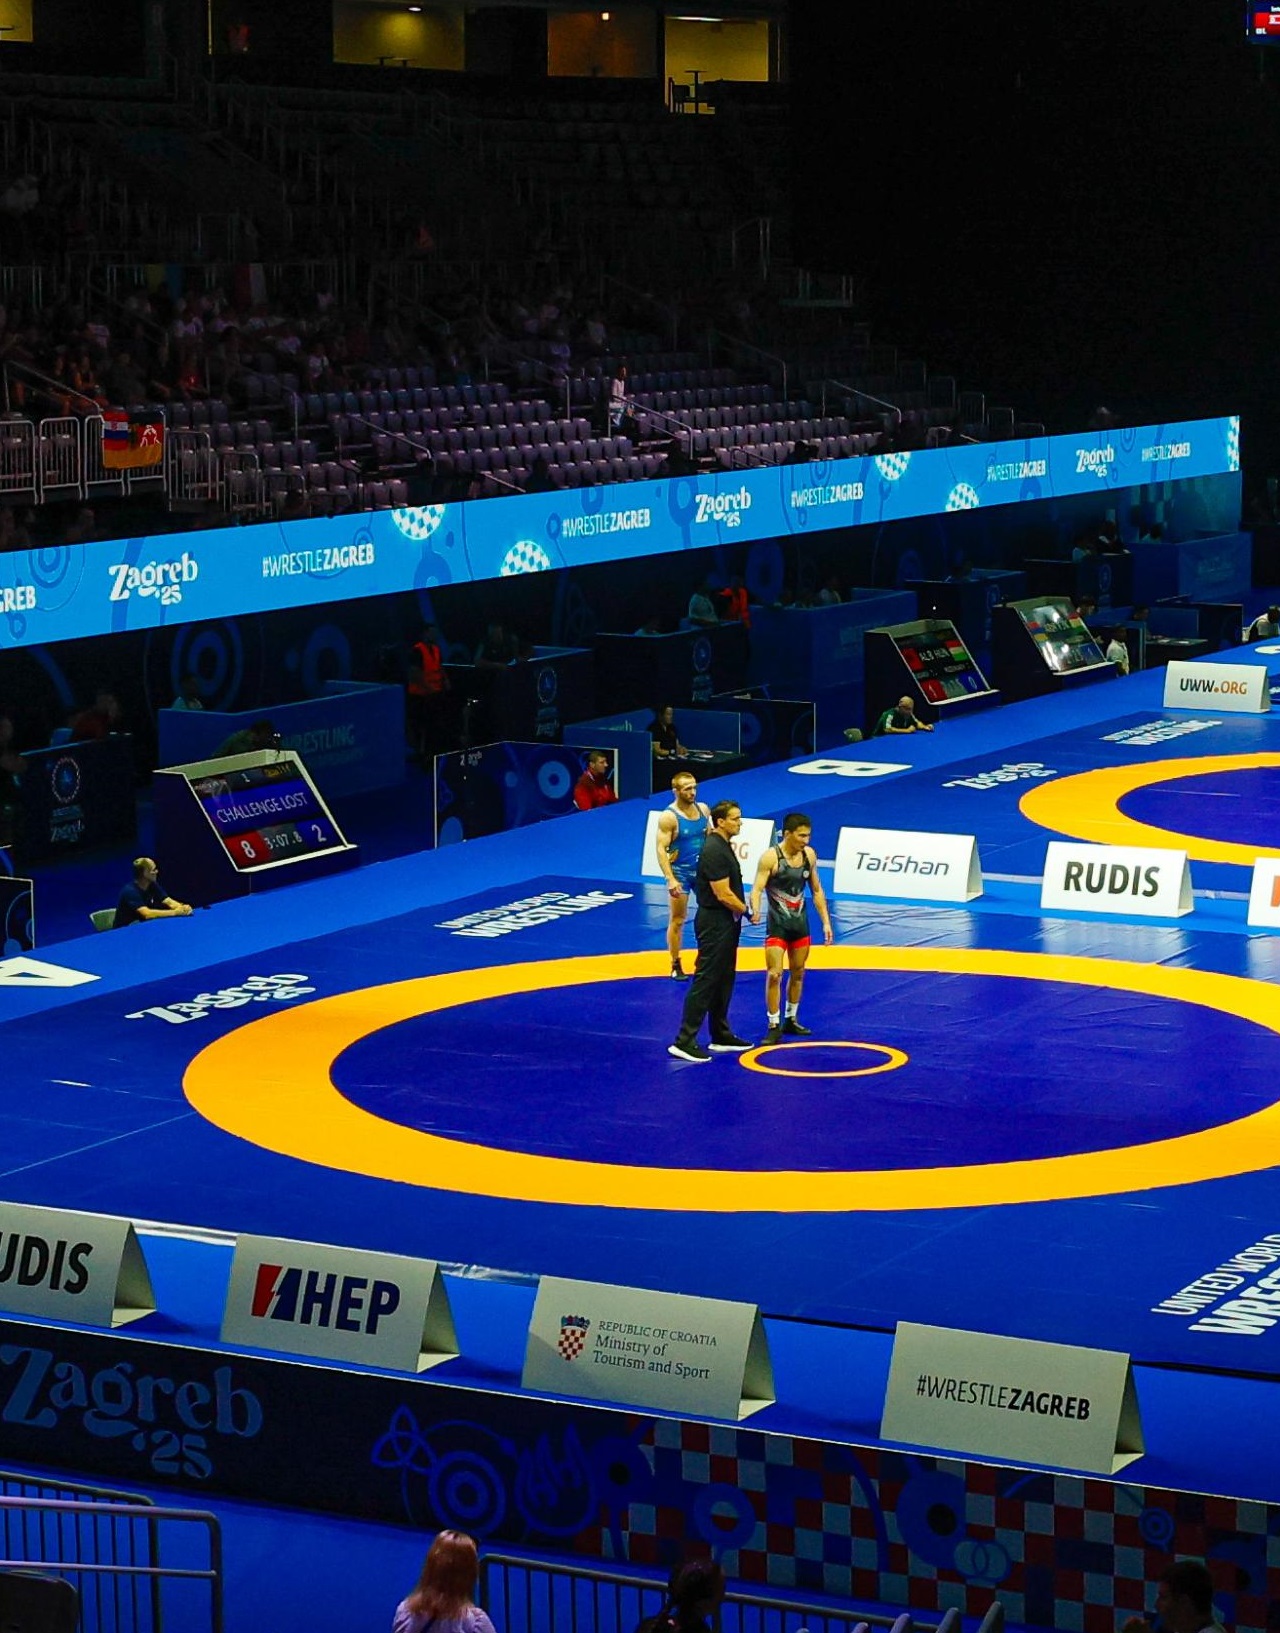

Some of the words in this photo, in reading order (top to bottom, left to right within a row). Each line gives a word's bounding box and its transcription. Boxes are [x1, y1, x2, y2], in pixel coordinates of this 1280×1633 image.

[1076, 444, 1115, 472] Zagreb
[694, 486, 751, 524] Zagreb
[562, 508, 651, 539] #WRESTLEZAGREB
[262, 542, 375, 578] #WRESTLEZAGREB
[108, 552, 198, 601] Zagreb
[1180, 678, 1248, 696] UWW.ORG
[787, 758, 912, 778] B
[216, 798, 282, 823] CHALLENGE
[280, 792, 308, 810] LOST
[311, 824, 327, 842] 2
[240, 840, 256, 859] 8
[855, 852, 950, 877] TaiShan
[1063, 860, 1160, 898] RUDIS
[451, 890, 634, 938] WRESTLING
[125, 973, 308, 1024] Zagreb
[300, 1268, 400, 1335] HEP
[1151, 1271, 1231, 1316] UNITED
[596, 1334, 646, 1358] Ministry
[650, 1342, 666, 1356] of
[599, 1320, 650, 1338] REPUBLIC
[652, 1327, 666, 1339] OF
[668, 1328, 718, 1346] CROATIA
[593, 1350, 644, 1372] Tourism
[648, 1356, 672, 1372] and
[675, 1361, 711, 1380] Sport
[1, 1344, 263, 1438] Zagreb
[916, 1374, 1091, 1421] #WRESTLEZAGREB
